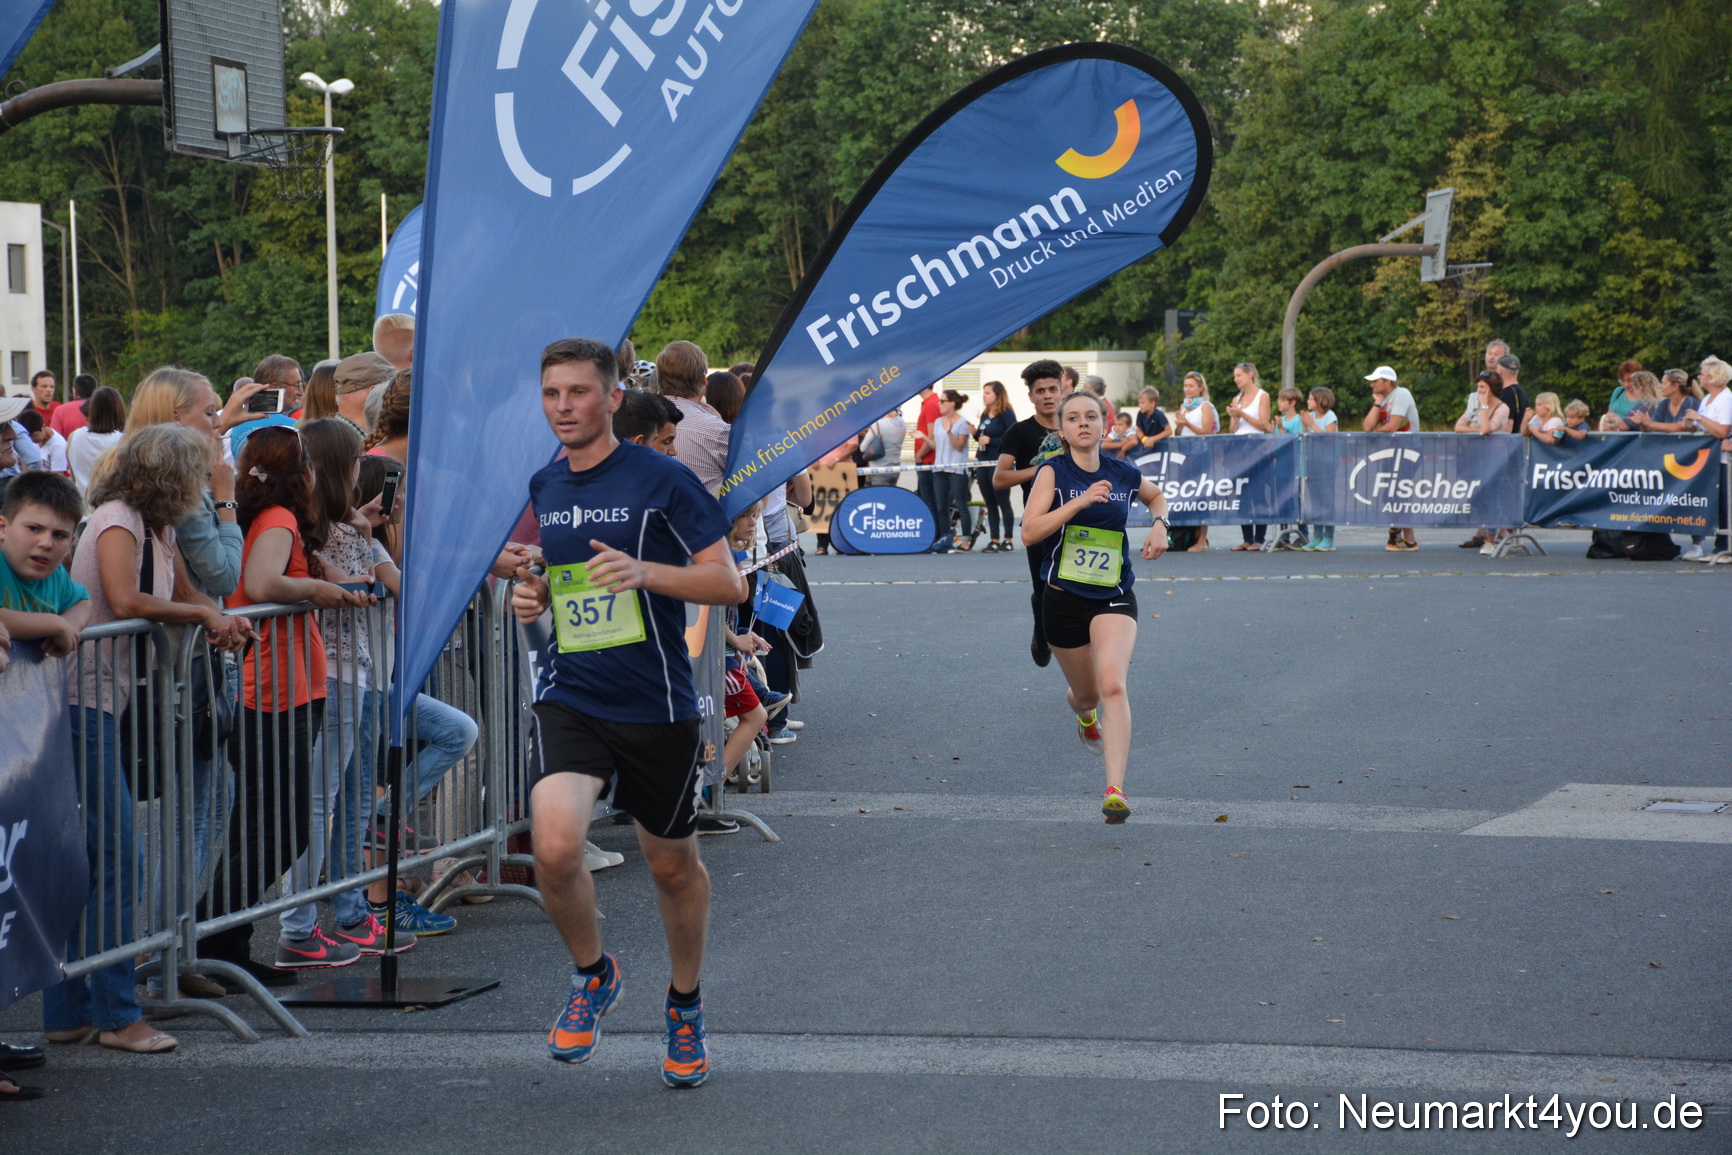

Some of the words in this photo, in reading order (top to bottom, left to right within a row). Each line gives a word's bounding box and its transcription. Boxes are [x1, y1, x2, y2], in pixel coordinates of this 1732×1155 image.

[989, 240, 1056, 289] Druck
[1058, 217, 1103, 248] und
[1102, 169, 1182, 227] Medien
[806, 187, 1087, 365] Frischmann
[720, 365, 901, 497] www.frischmann-net.de
[1372, 472, 1481, 499] Fischer
[1532, 463, 1664, 490] Frischmann
[1382, 502, 1471, 514] AUTOMOBILE
[1608, 491, 1641, 505] Druck
[540, 511, 571, 527] EURO
[584, 508, 629, 523] POLES
[863, 515, 923, 531] Fischer
[870, 531, 921, 539] AUTOMOBILE
[1074, 548, 1110, 571] 372
[566, 594, 616, 627] 357
